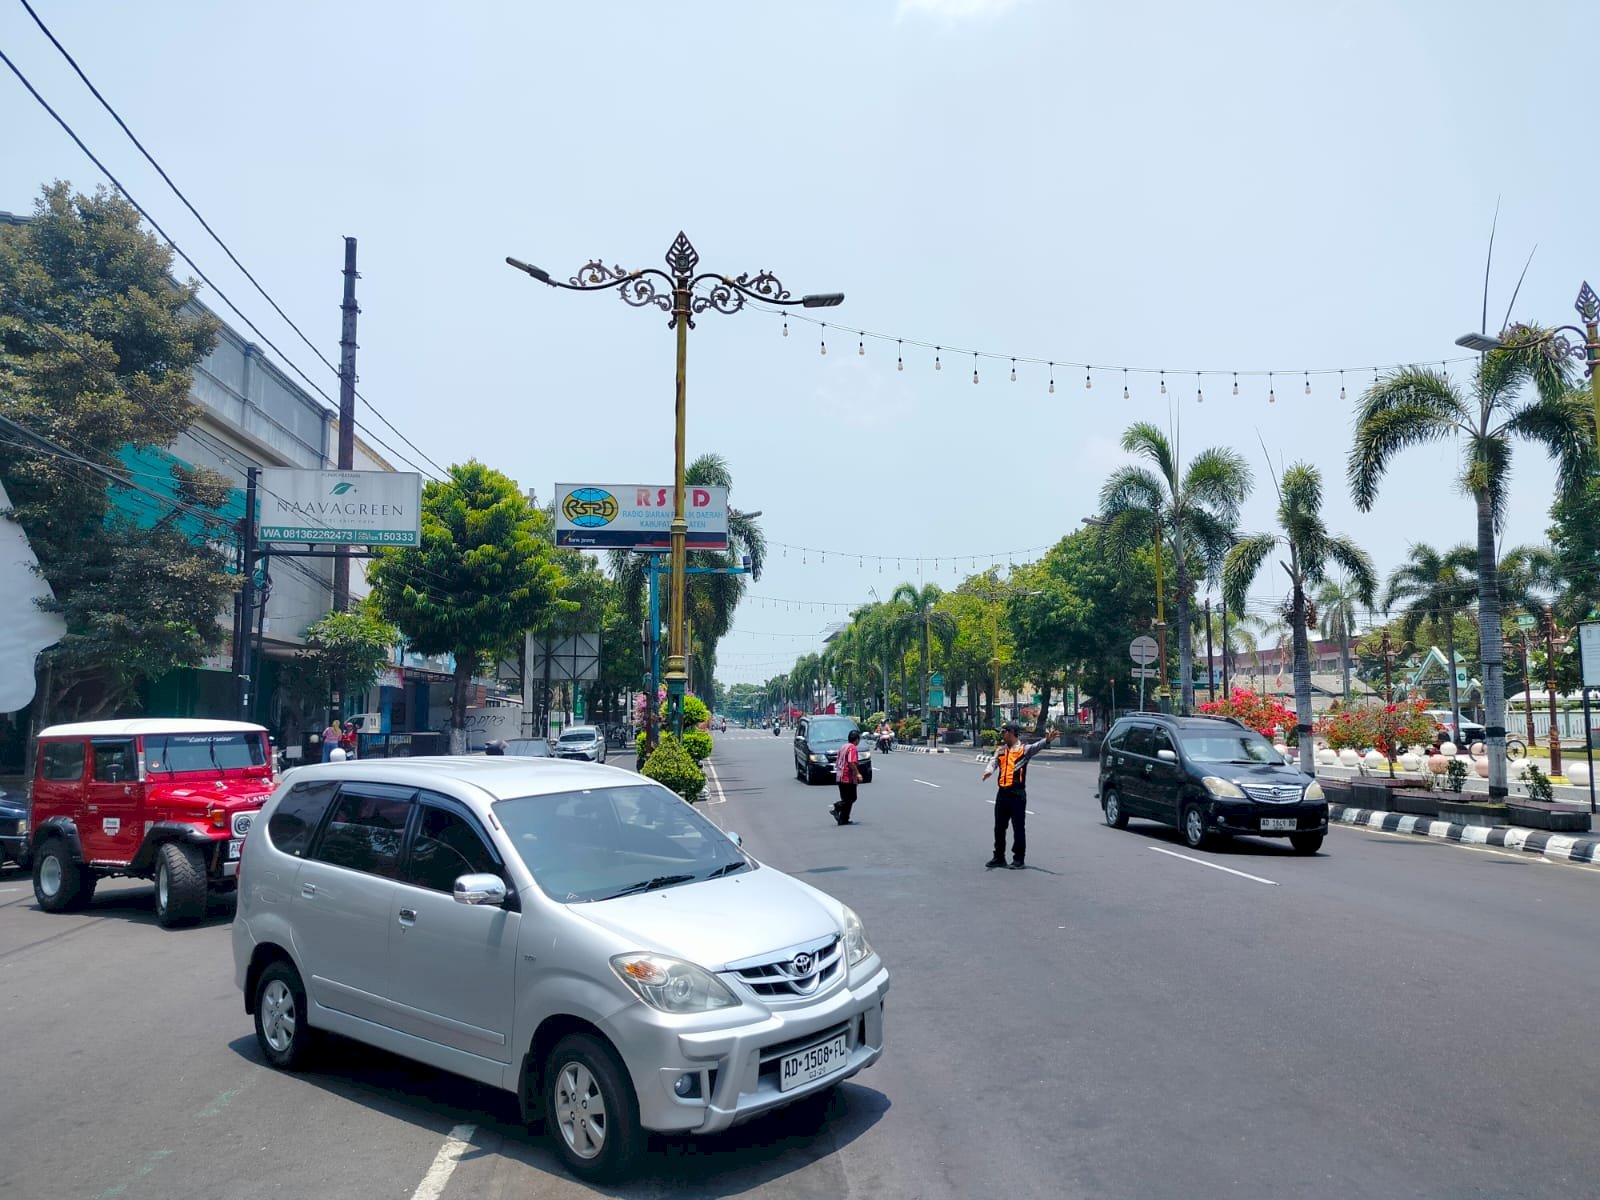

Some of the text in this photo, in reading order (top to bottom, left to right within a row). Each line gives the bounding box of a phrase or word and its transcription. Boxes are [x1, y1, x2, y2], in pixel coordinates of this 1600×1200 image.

[277, 501, 403, 516] NAAVAGREEN
[622, 510, 645, 518] RADIO
[697, 511, 723, 519] DAERAH
[263, 529, 281, 538] WA
[378, 532, 414, 542] 150333
[784, 1039, 845, 1079] AD 1508 FL
